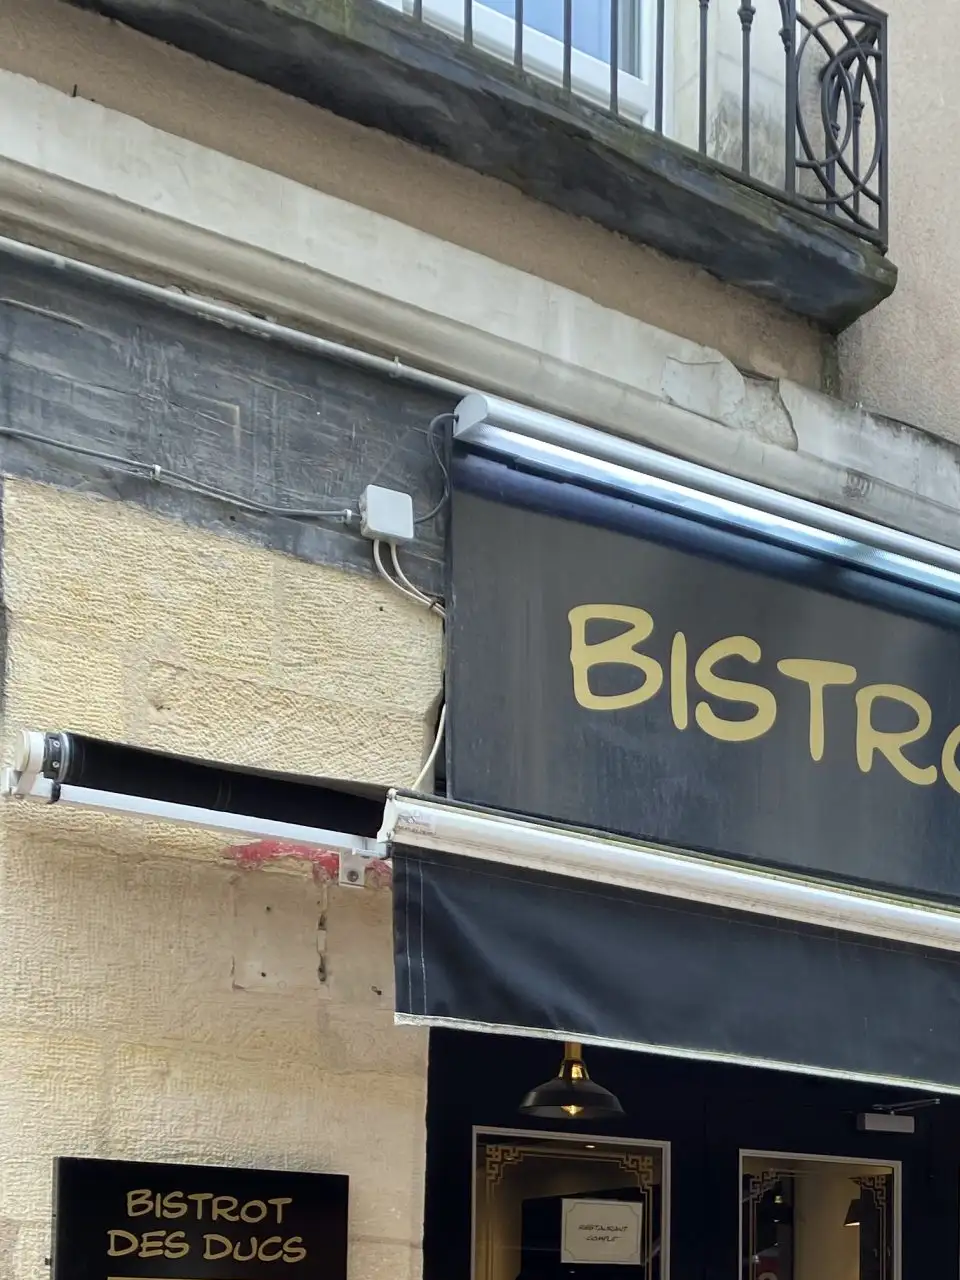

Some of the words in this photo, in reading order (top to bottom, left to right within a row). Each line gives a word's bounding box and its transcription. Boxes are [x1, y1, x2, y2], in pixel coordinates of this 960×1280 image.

[126, 1189, 292, 1224] BISTROT
[107, 1229, 190, 1259] DES
[203, 1233, 307, 1263] DUCS
